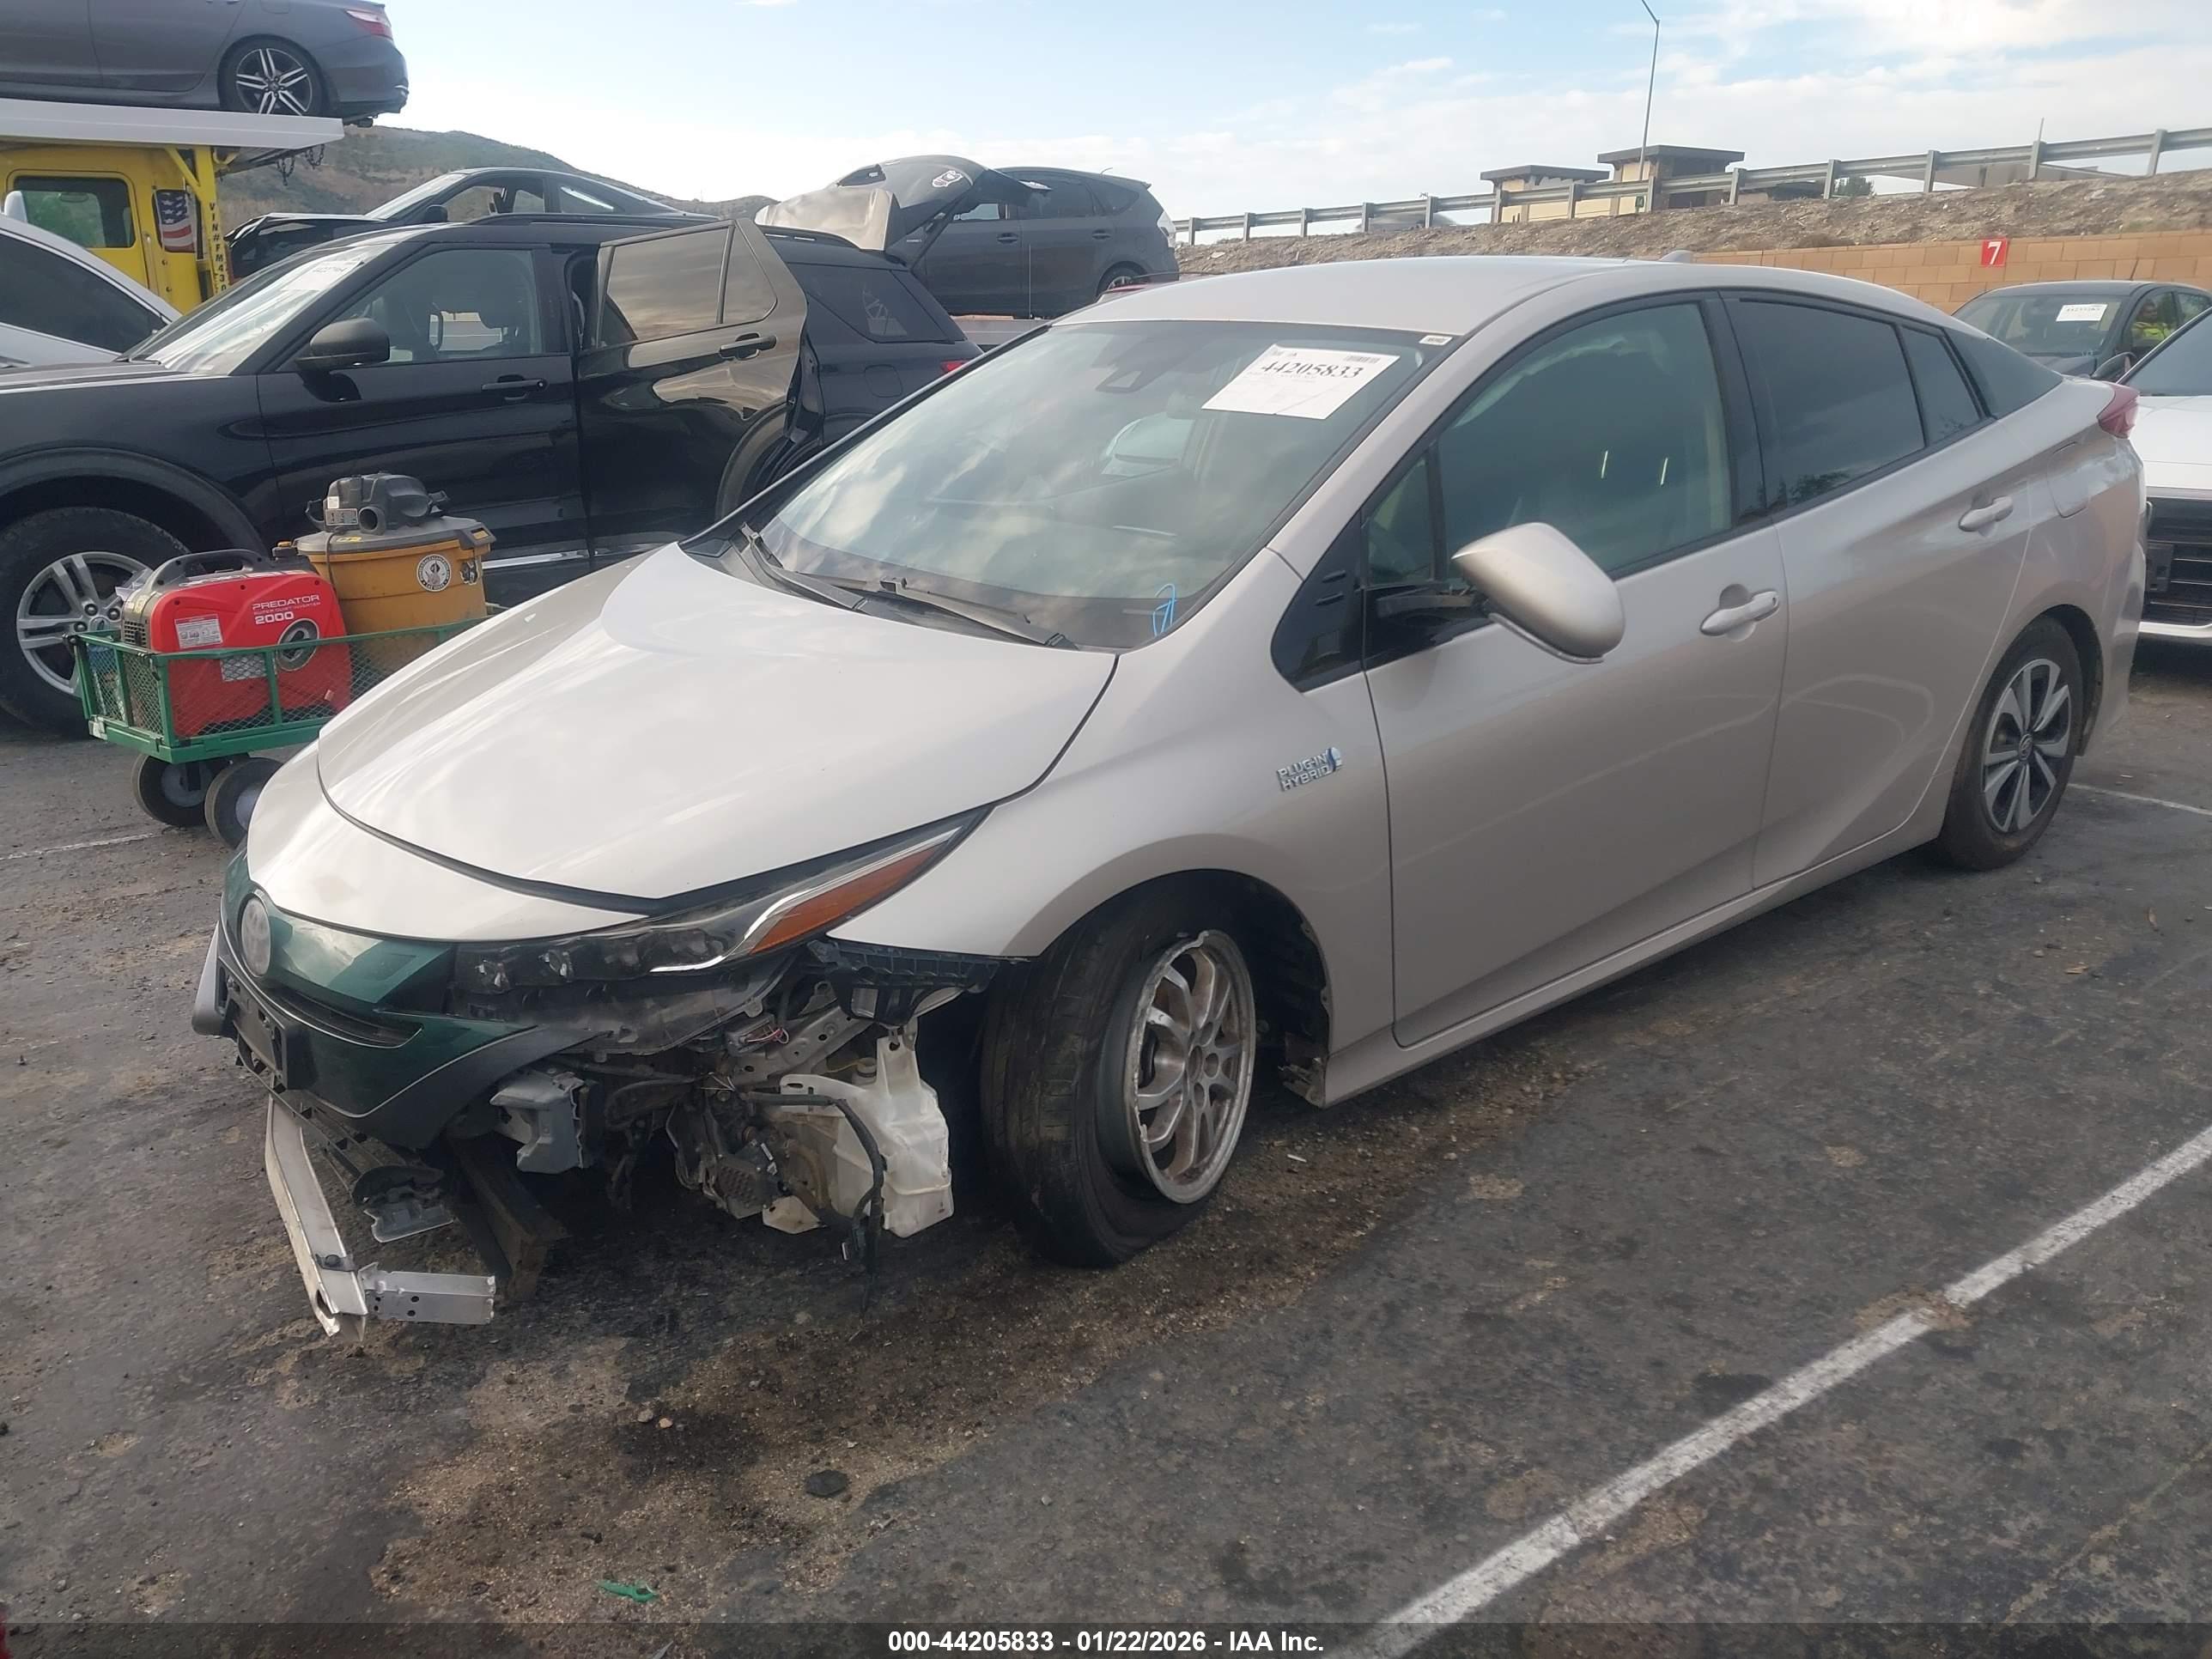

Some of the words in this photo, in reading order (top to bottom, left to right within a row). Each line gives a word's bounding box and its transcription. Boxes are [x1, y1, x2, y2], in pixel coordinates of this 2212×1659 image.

[1987, 241, 2002, 264] 7
[1261, 361, 1364, 379] 44205833
[252, 594, 319, 611] PREDATOR
[255, 611, 295, 625] 2000
[1277, 754, 1328, 776] PLUG-IN
[1280, 764, 1332, 791] HYBRID
